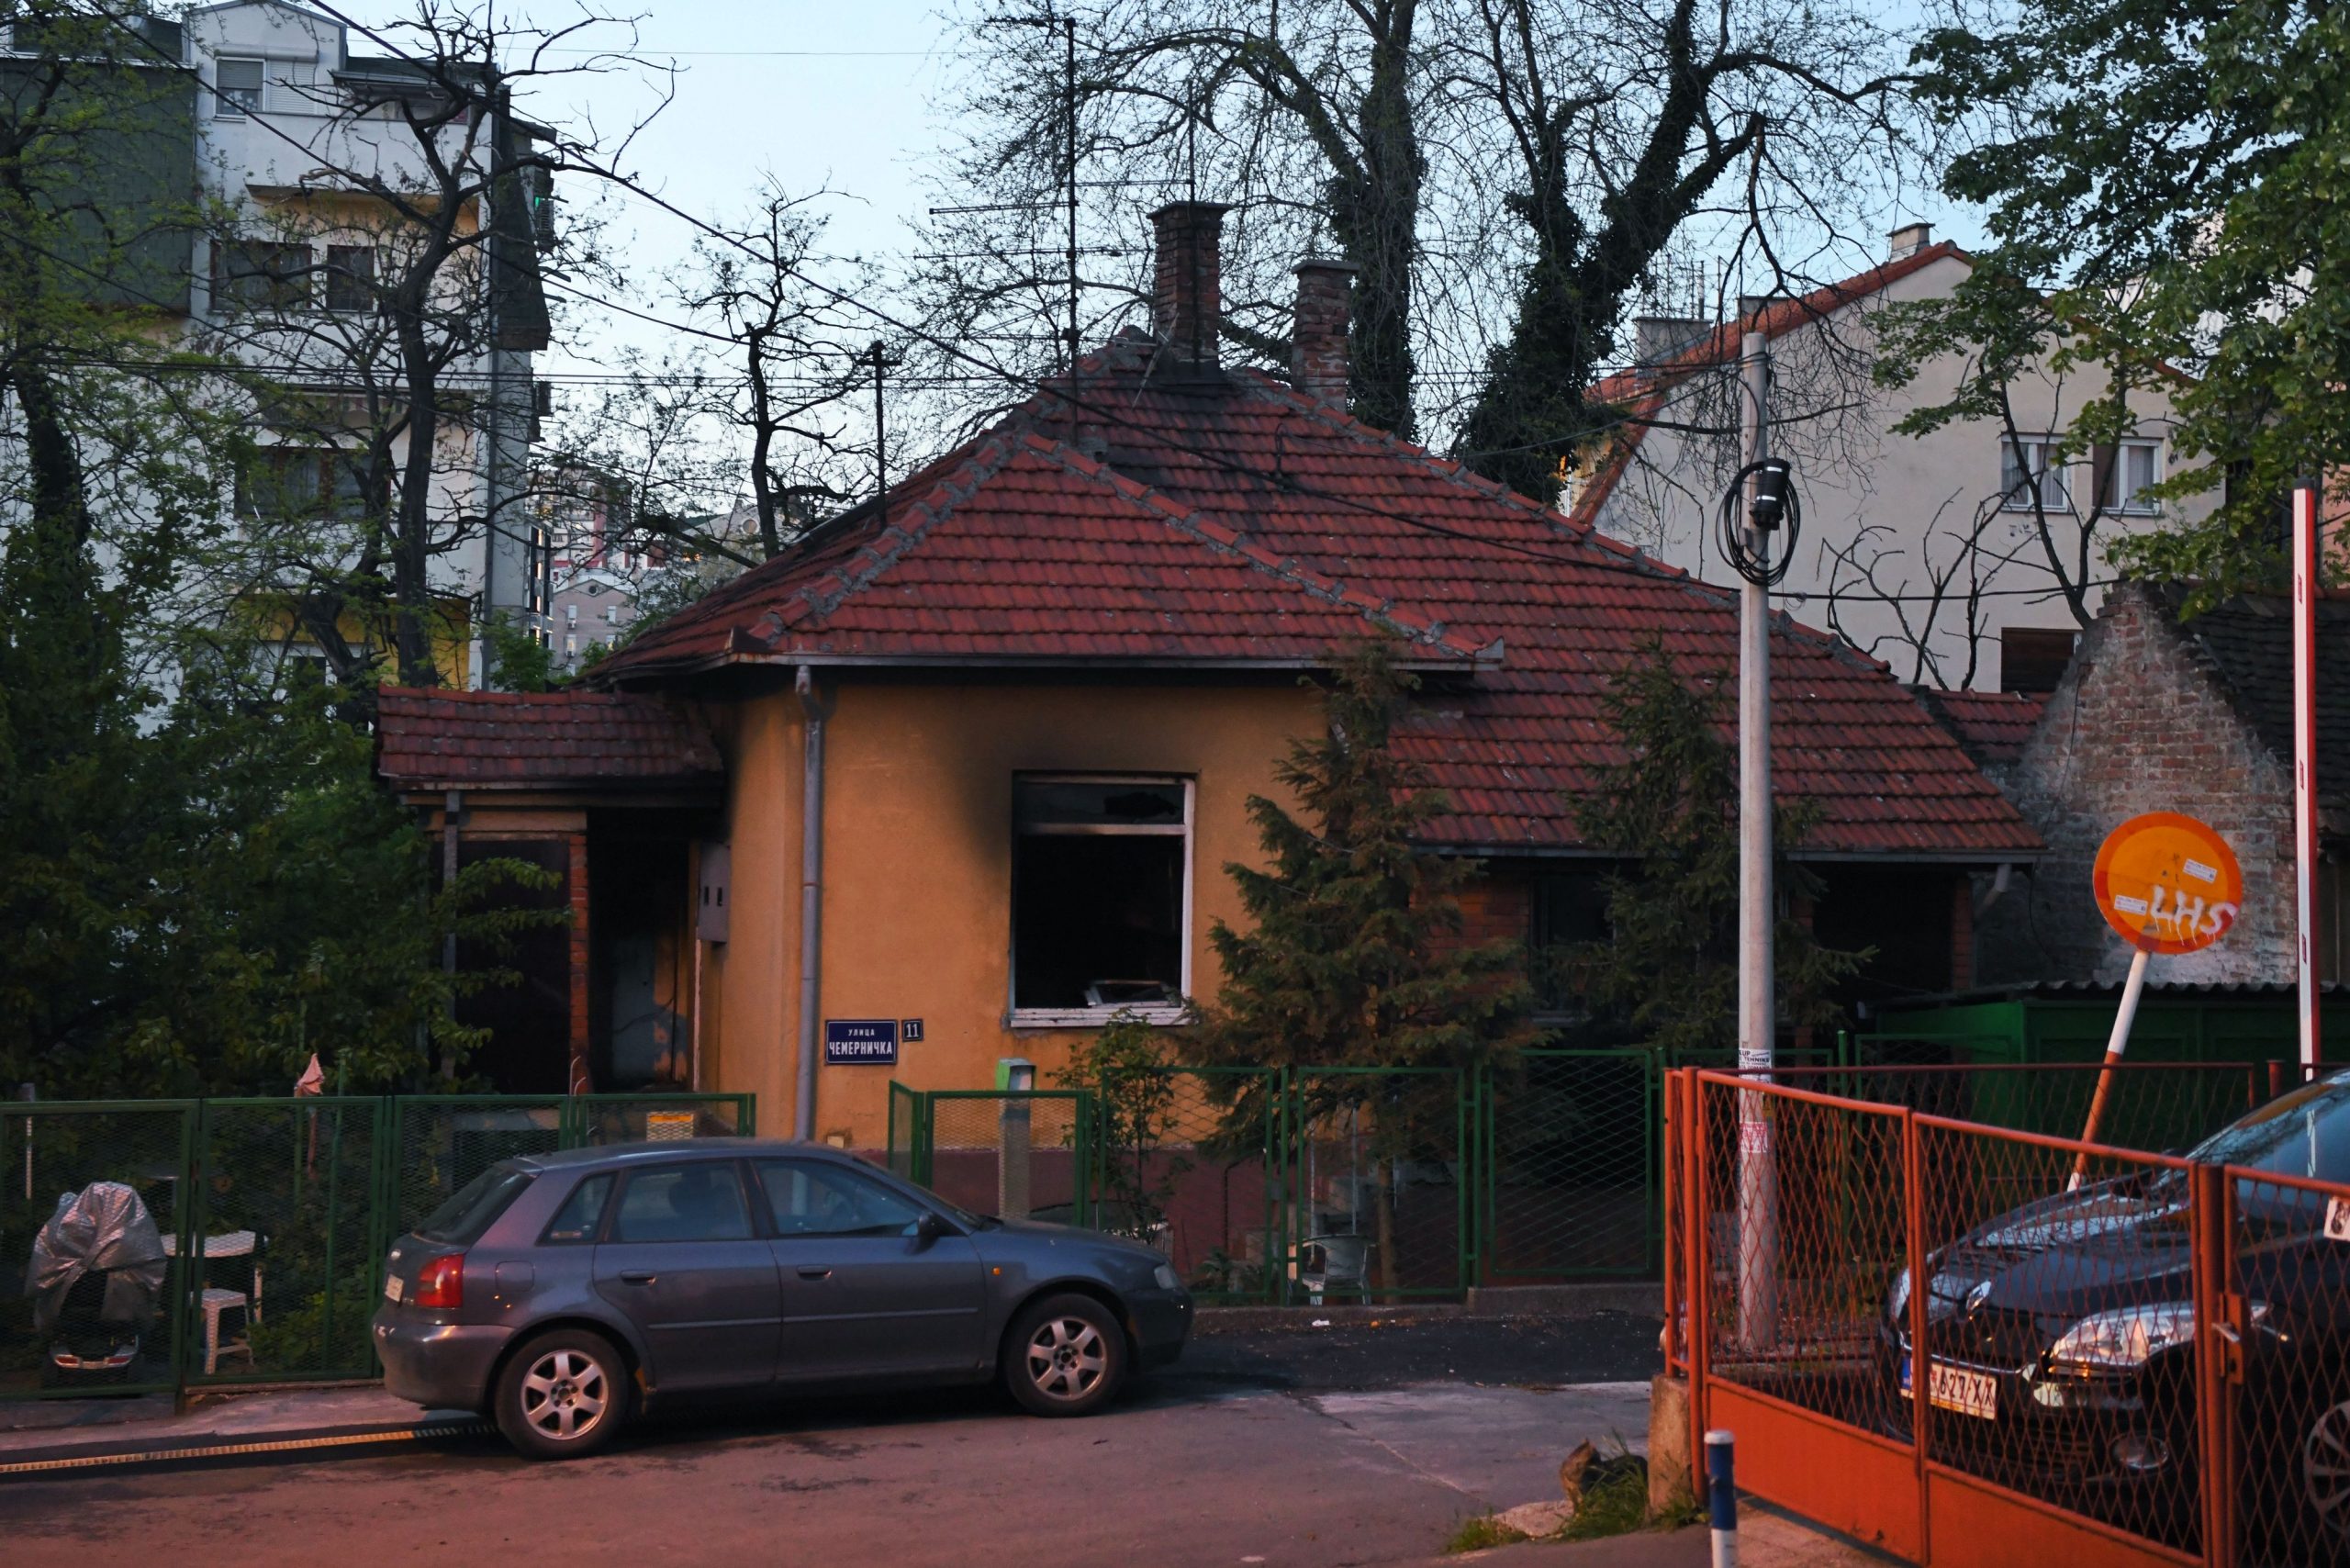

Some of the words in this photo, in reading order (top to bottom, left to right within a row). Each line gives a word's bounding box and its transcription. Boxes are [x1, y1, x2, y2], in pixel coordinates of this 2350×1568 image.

[2151, 884, 2238, 935] LHS
[905, 1024, 919, 1037] 11
[829, 1041, 893, 1055] ЧЕМЕРНИЧКА
